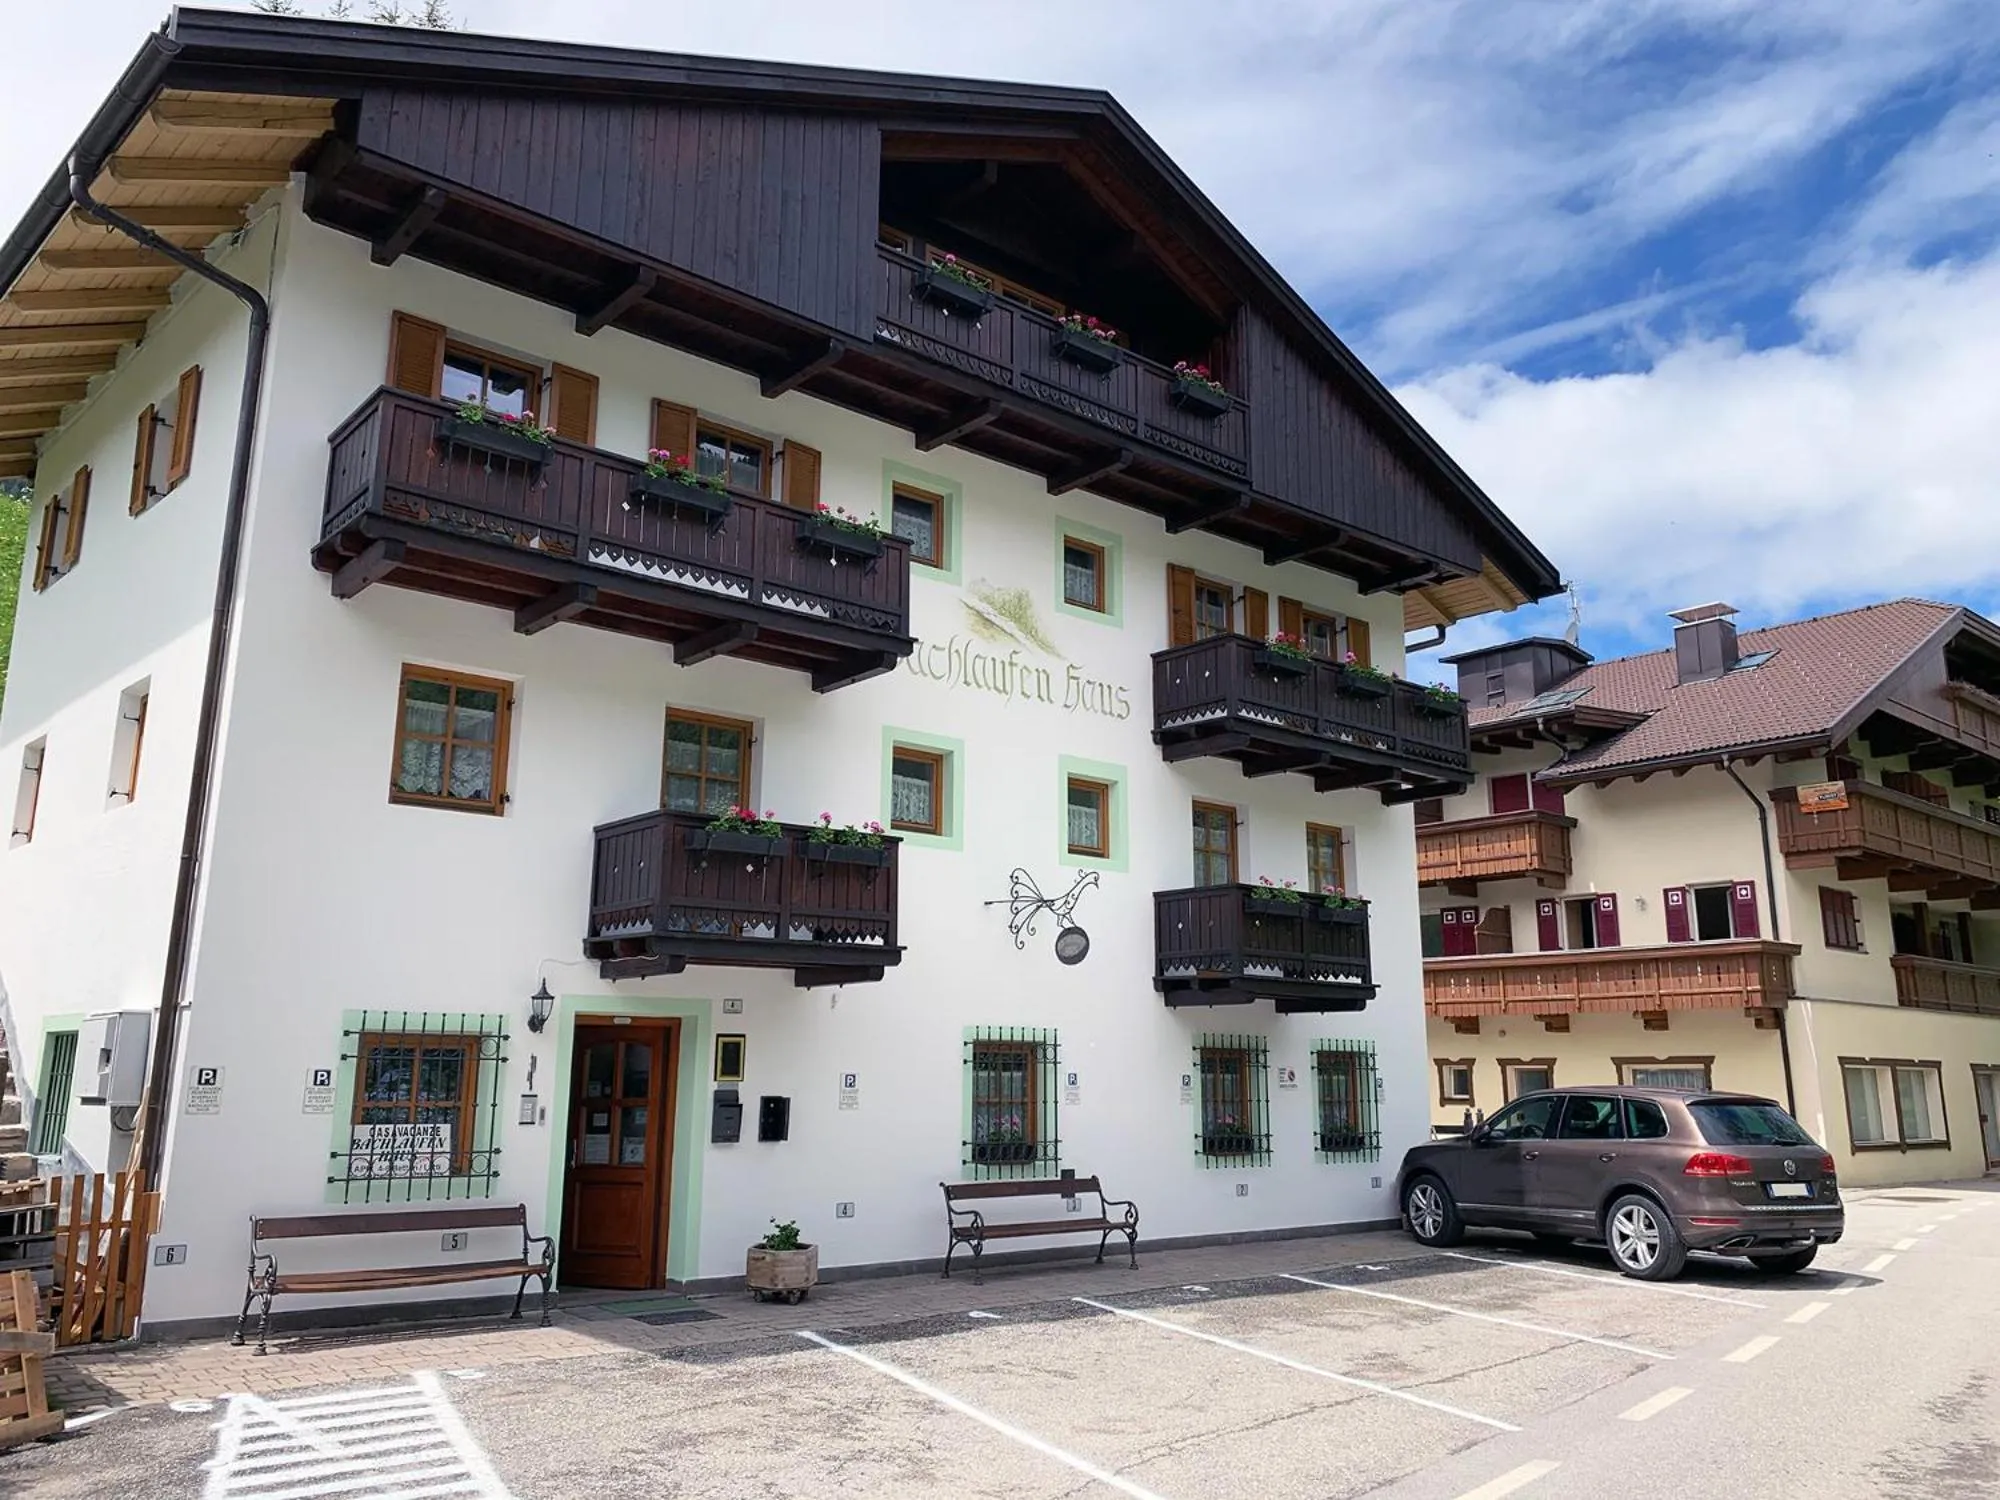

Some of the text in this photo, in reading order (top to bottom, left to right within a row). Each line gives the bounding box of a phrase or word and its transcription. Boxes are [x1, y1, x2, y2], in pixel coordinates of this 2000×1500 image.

[899, 633, 1131, 720] achlaufen Haus
[201, 1070, 214, 1084] P
[316, 1071, 328, 1085] P
[451, 1234, 458, 1249] 5
[166, 1247, 175, 1264] 6
